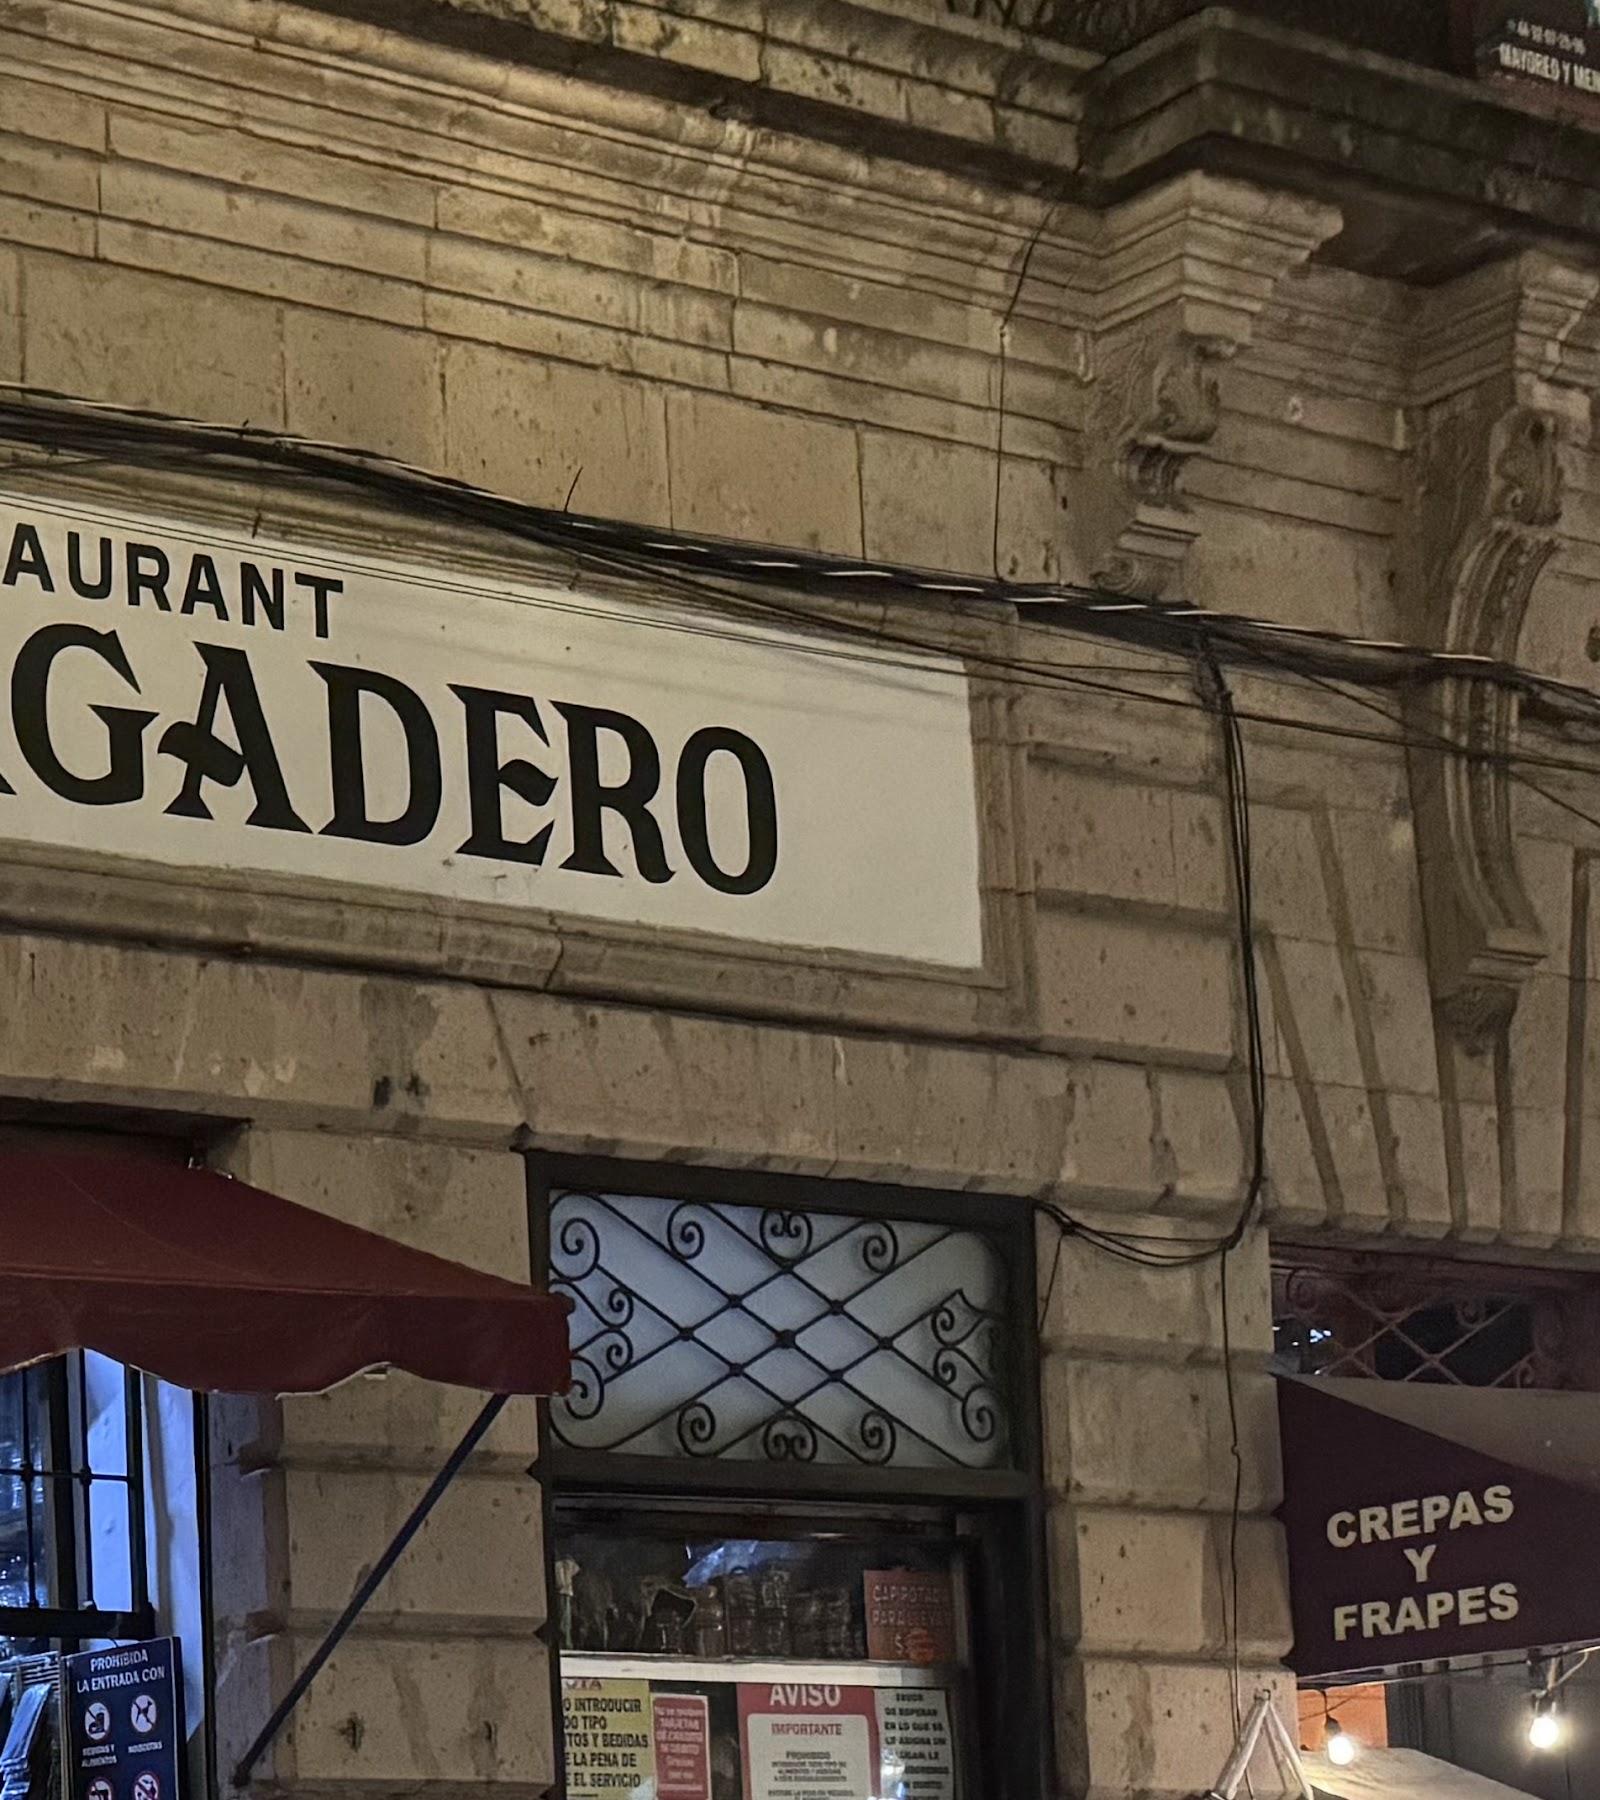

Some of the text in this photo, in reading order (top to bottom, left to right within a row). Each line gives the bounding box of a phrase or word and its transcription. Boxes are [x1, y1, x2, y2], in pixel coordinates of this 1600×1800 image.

[1327, 1485, 1514, 1548] CREPAS
[1403, 1544, 1437, 1583] Y
[1334, 1582, 1519, 1641] FRAPES
[91, 1649, 148, 1672] PROHIBIDA
[77, 1666, 165, 1693] LA ENTRADA CON
[769, 1684, 841, 1707] AVISO
[575, 1698, 641, 1713] INTRODUCIR
[582, 1716, 607, 1729] TIPO
[771, 1723, 842, 1736] IMPORTANTE
[593, 1733, 599, 1748] Y
[573, 1752, 588, 1767] LA
[621, 1753, 636, 1767] DE
[574, 1773, 587, 1787] EL
[590, 1773, 640, 1788] SERVICIO
